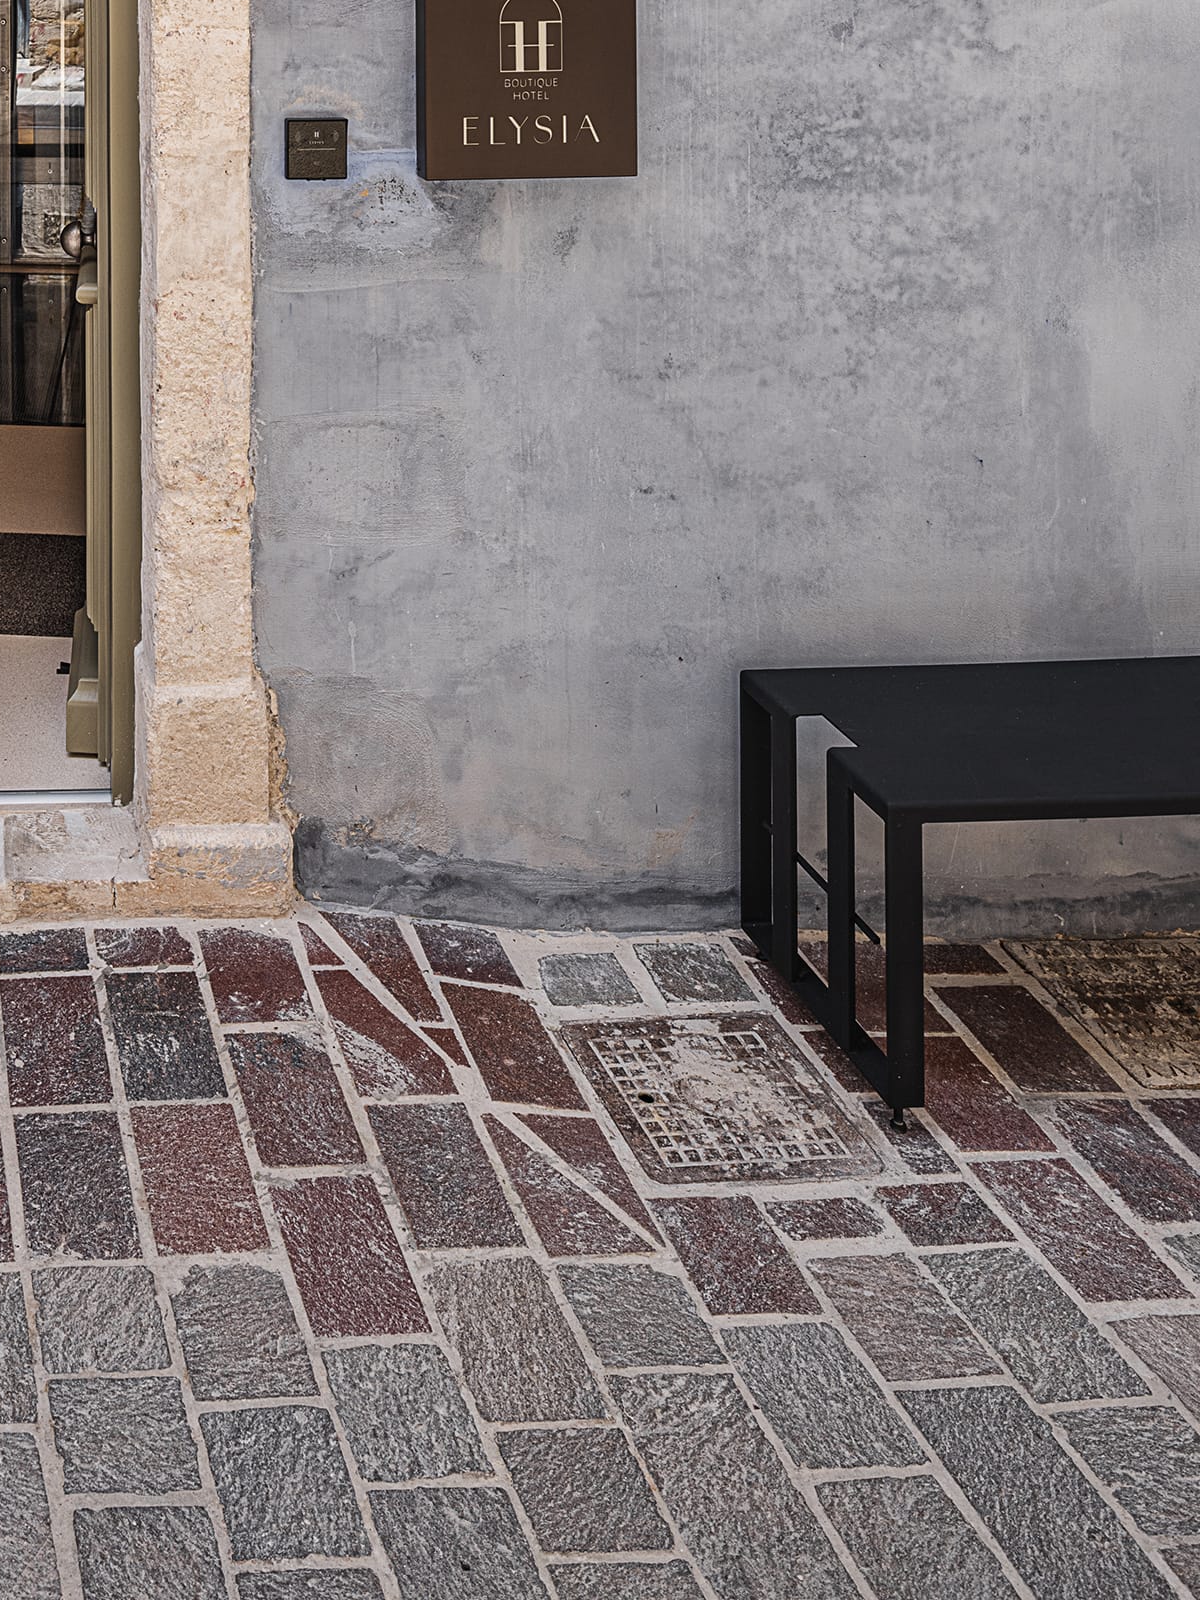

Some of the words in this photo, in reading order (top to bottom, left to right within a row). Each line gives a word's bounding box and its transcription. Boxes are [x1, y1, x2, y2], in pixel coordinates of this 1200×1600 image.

[504, 77, 558, 88] BOUTIQUE
[513, 90, 549, 100] HOTEL
[463, 115, 600, 145] ELYSIA
